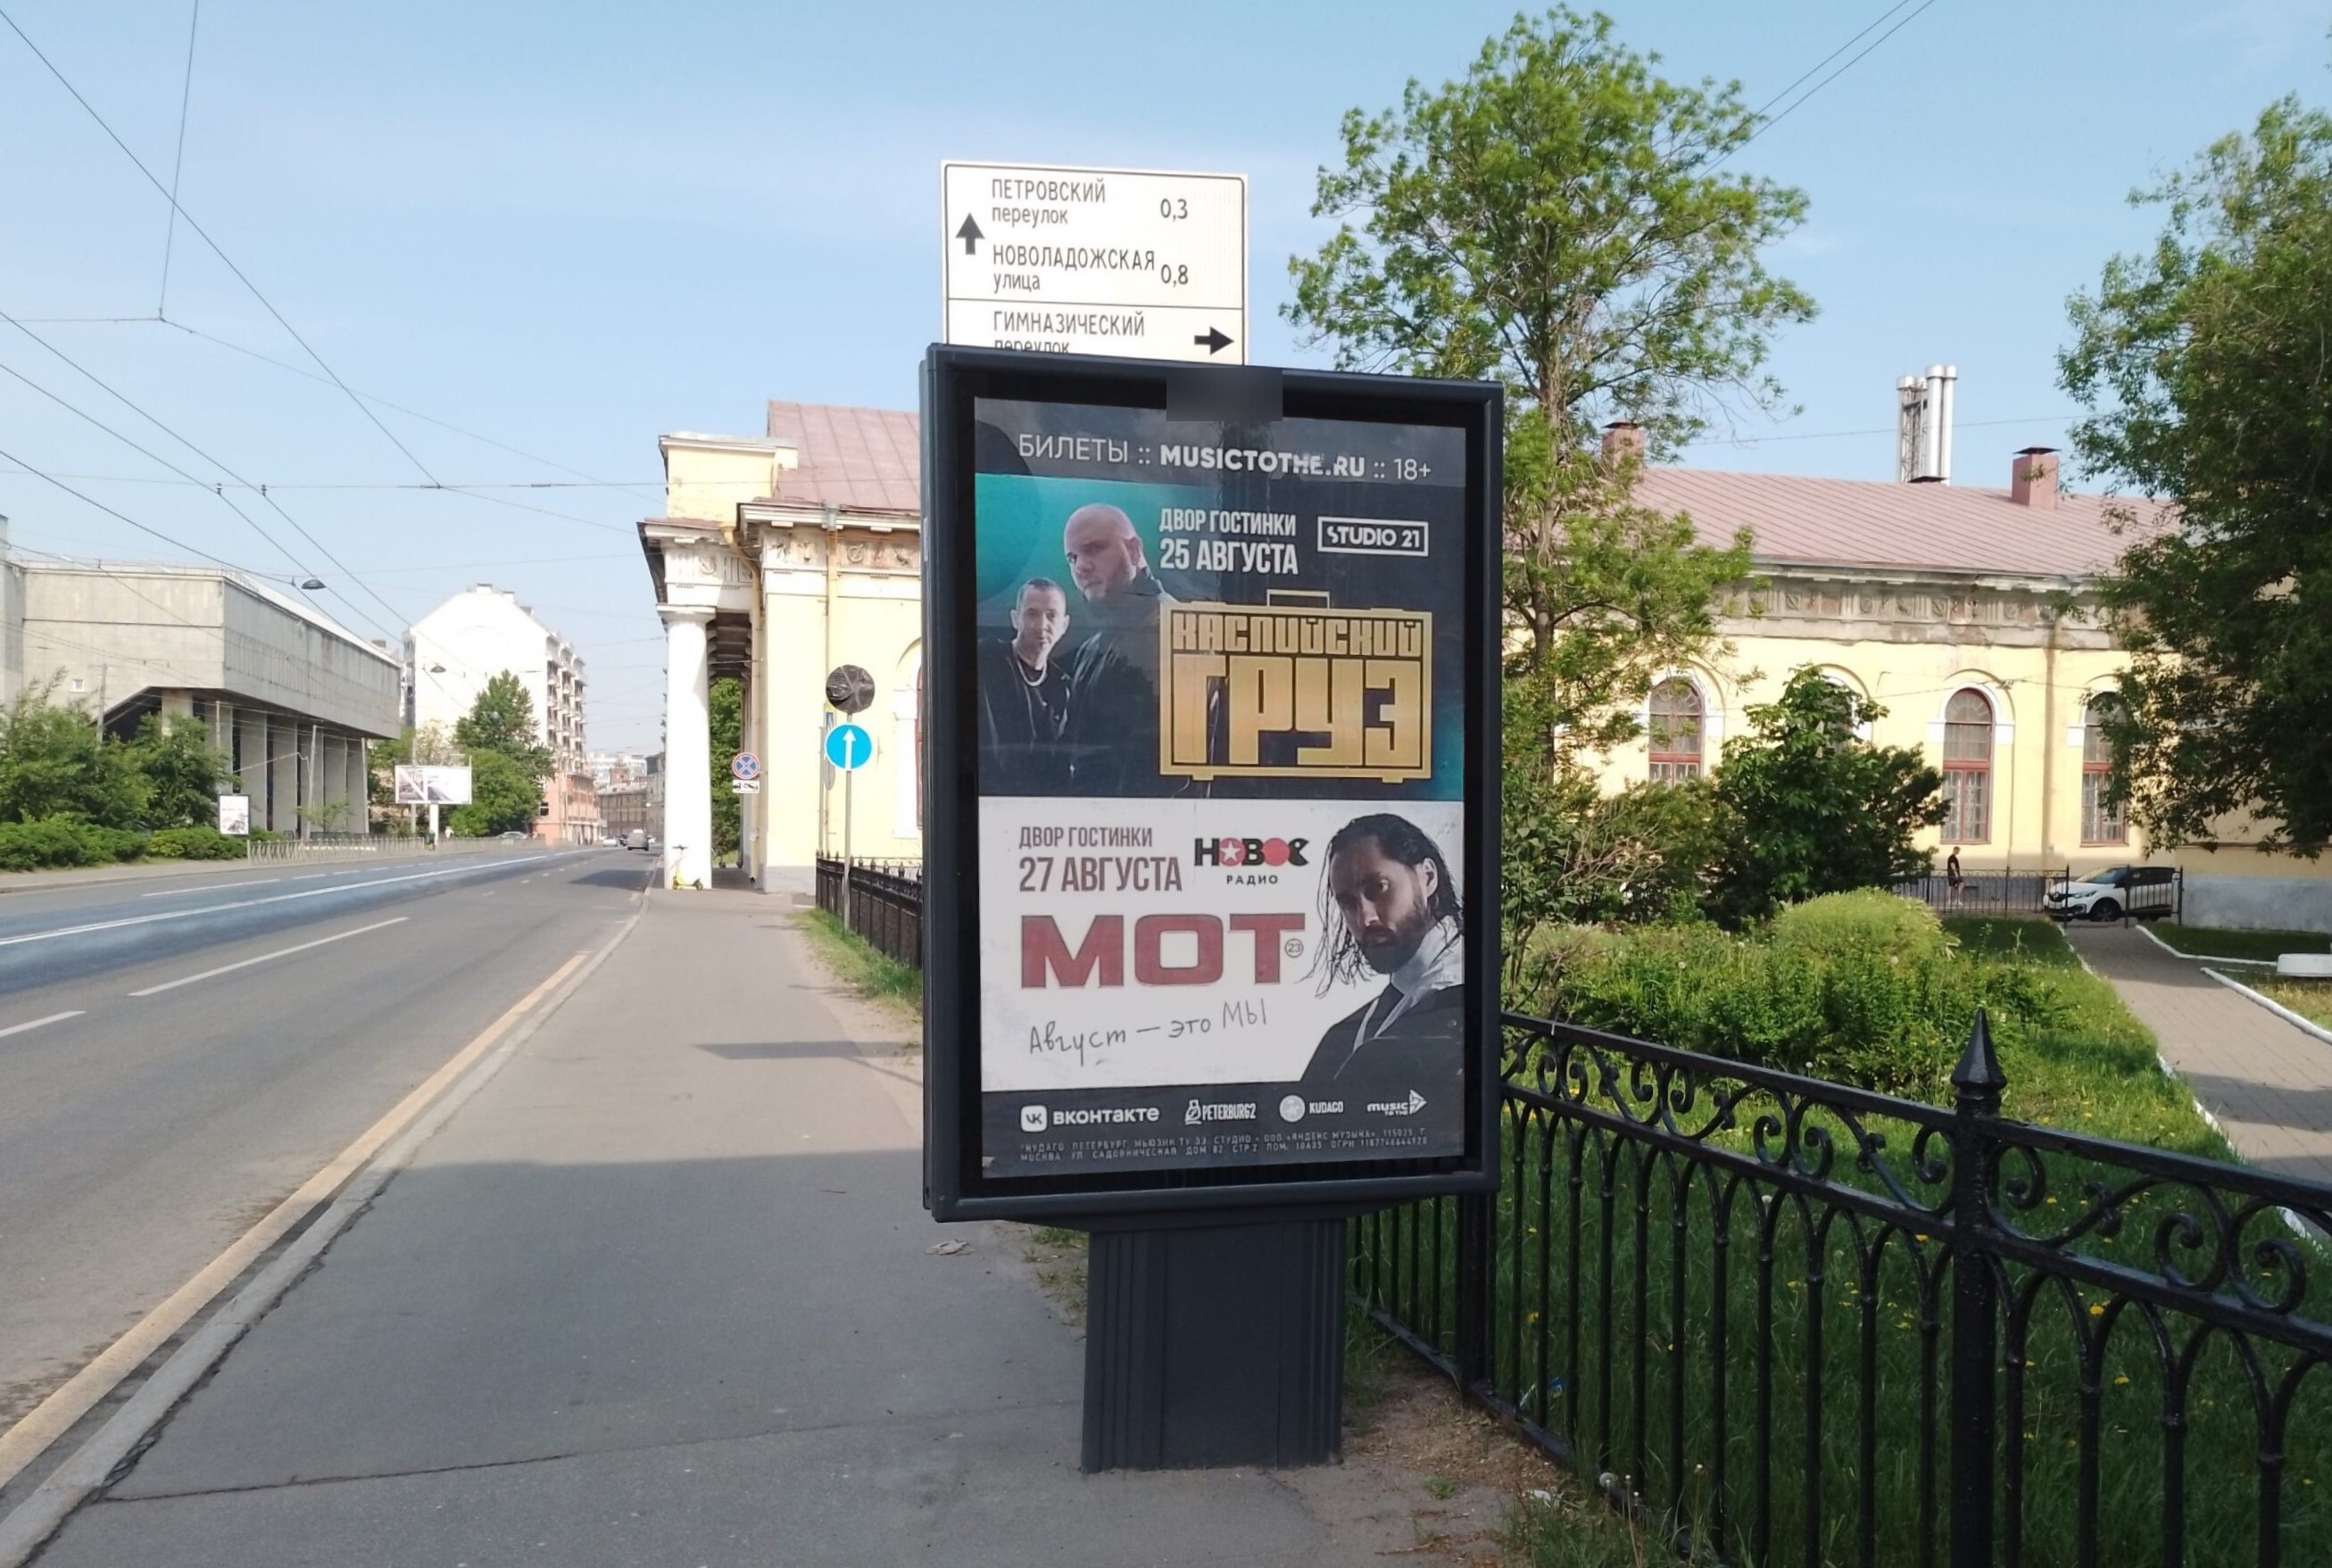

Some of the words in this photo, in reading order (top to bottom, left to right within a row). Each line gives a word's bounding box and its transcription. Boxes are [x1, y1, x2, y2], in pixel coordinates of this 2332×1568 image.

[992, 178, 1106, 203] ПЕТРОВСКИЙ
[992, 206, 1068, 228] переулок
[1160, 198, 1189, 222] 0,3
[992, 245, 1156, 271] НОВОЛАДОЖСКАЯ
[992, 273, 1041, 294] улица
[1160, 264, 1189, 288] 0,8
[993, 311, 1145, 336] ГИМНАЗИЧЕСКИЙ
[1018, 434, 1128, 463] БИЛЕТЫ
[1160, 444, 1365, 477] MUSICTOTHE.RU
[1393, 458, 1432, 481] 18+
[1158, 507, 1207, 533] ДВОР
[1209, 510, 1297, 536] ГОСТИНКИ
[1326, 525, 1397, 546] STUDIO
[1402, 529, 1421, 548] 21
[1159, 538, 1191, 569] 25
[1196, 540, 1299, 575] АВГУСТА
[1172, 612, 1423, 657] КАСПИЙСКИЙ
[1173, 653, 1422, 767] ГРУЗ
[1019, 826, 1065, 849] ДВОР
[1068, 826, 1153, 848] ГОСТИНКИ
[1019, 857, 1054, 892] 27
[1060, 856, 1183, 892] АВГУСТА
[1226, 875, 1279, 885] РАДИО
[1021, 913, 1306, 989] МОТ
[1029, 1021, 1127, 1067] Август
[1168, 1018, 1211, 1039] это
[1223, 998, 1267, 1029] МЫ
[1308, 1100, 1344, 1115] KUDAGO
